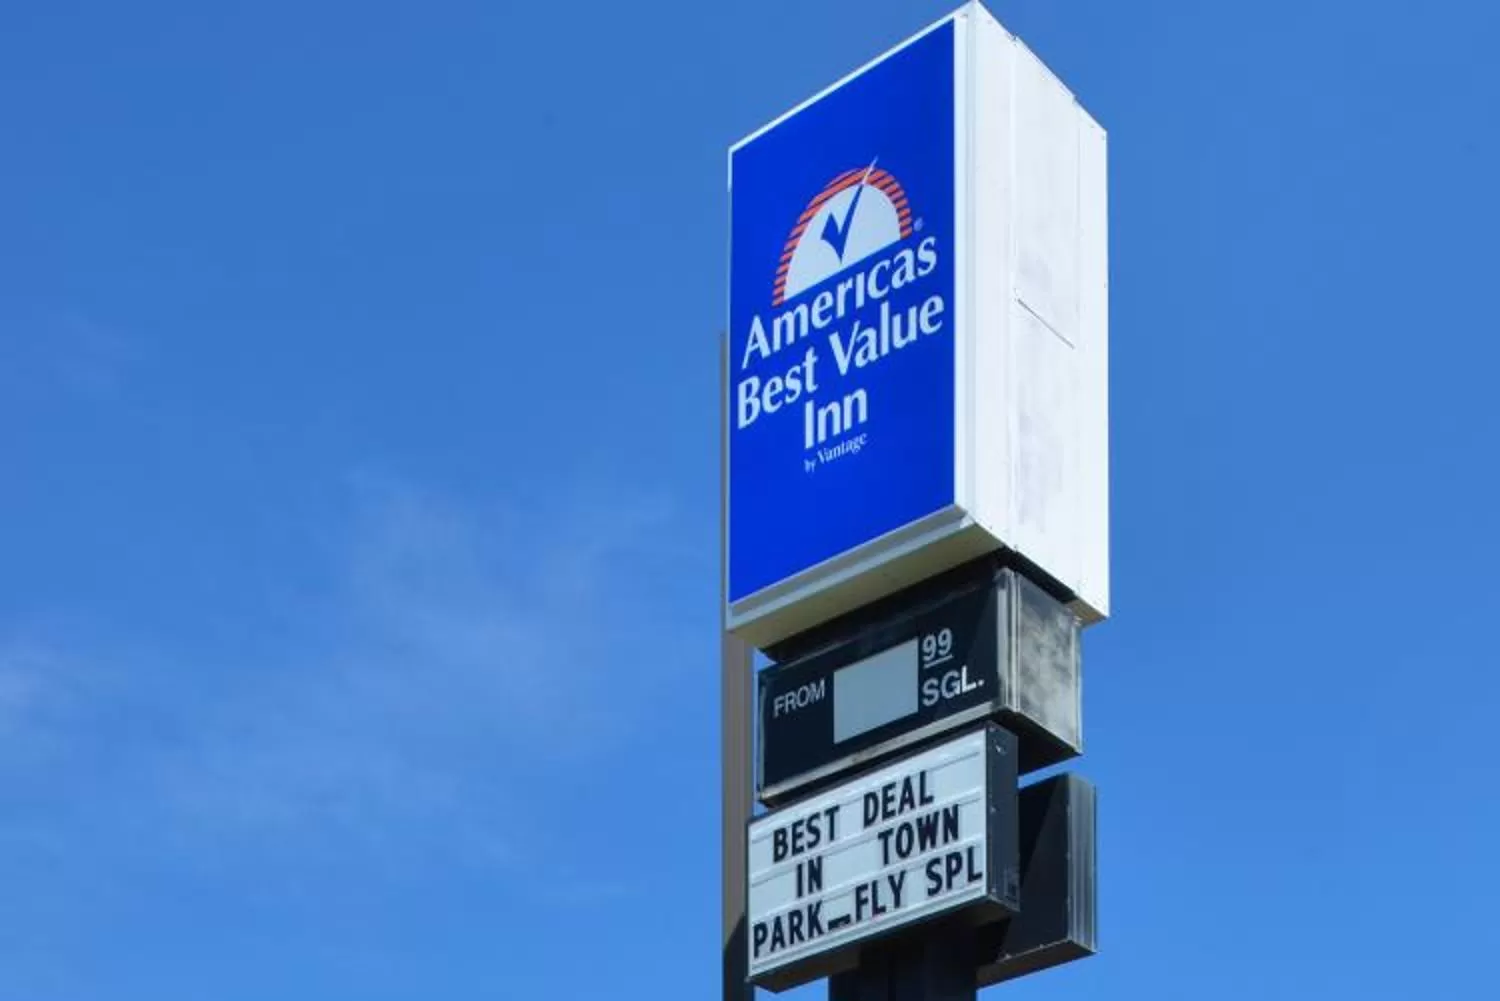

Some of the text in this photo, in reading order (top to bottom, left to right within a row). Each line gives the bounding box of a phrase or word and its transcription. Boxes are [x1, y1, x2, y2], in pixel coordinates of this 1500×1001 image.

[741, 236, 937, 370] Americas
[737, 295, 944, 429] Best Value
[804, 388, 868, 450] Inn
[817, 433, 867, 464] Vantage
[922, 628, 952, 661] 99
[773, 665, 985, 718] FROM SGL.
[773, 771, 935, 864] BEST DEAL
[796, 804, 960, 899] IN TOWN
[926, 846, 983, 897] SPL
